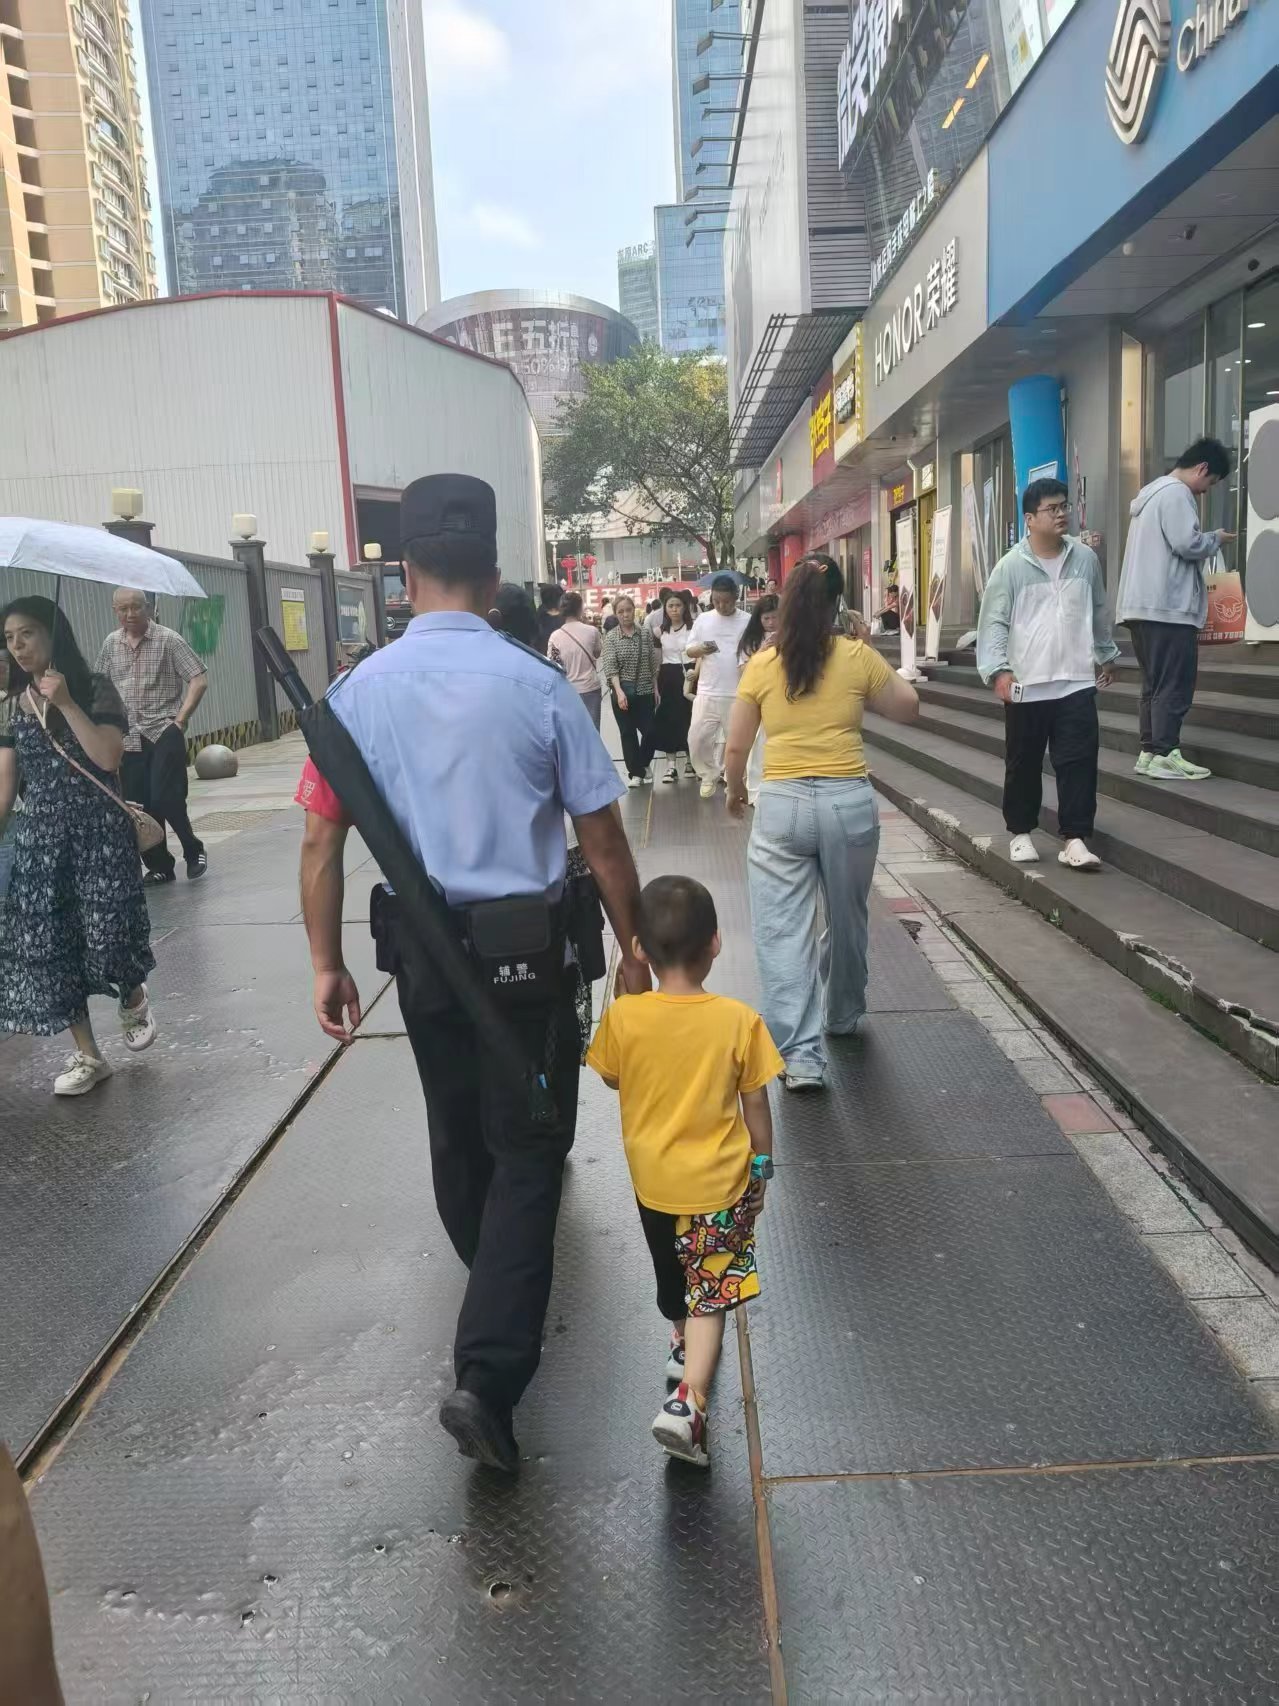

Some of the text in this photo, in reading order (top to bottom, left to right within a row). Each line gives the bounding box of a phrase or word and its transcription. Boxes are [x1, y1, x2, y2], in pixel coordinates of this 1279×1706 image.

[1177, 0, 1242, 72] China
[875, 236, 957, 386] HONOR 荣耀
[493, 972, 536, 984] FUJING
[498, 962, 528, 976] 辅警
[697, 1227, 706, 1255] GOOD
